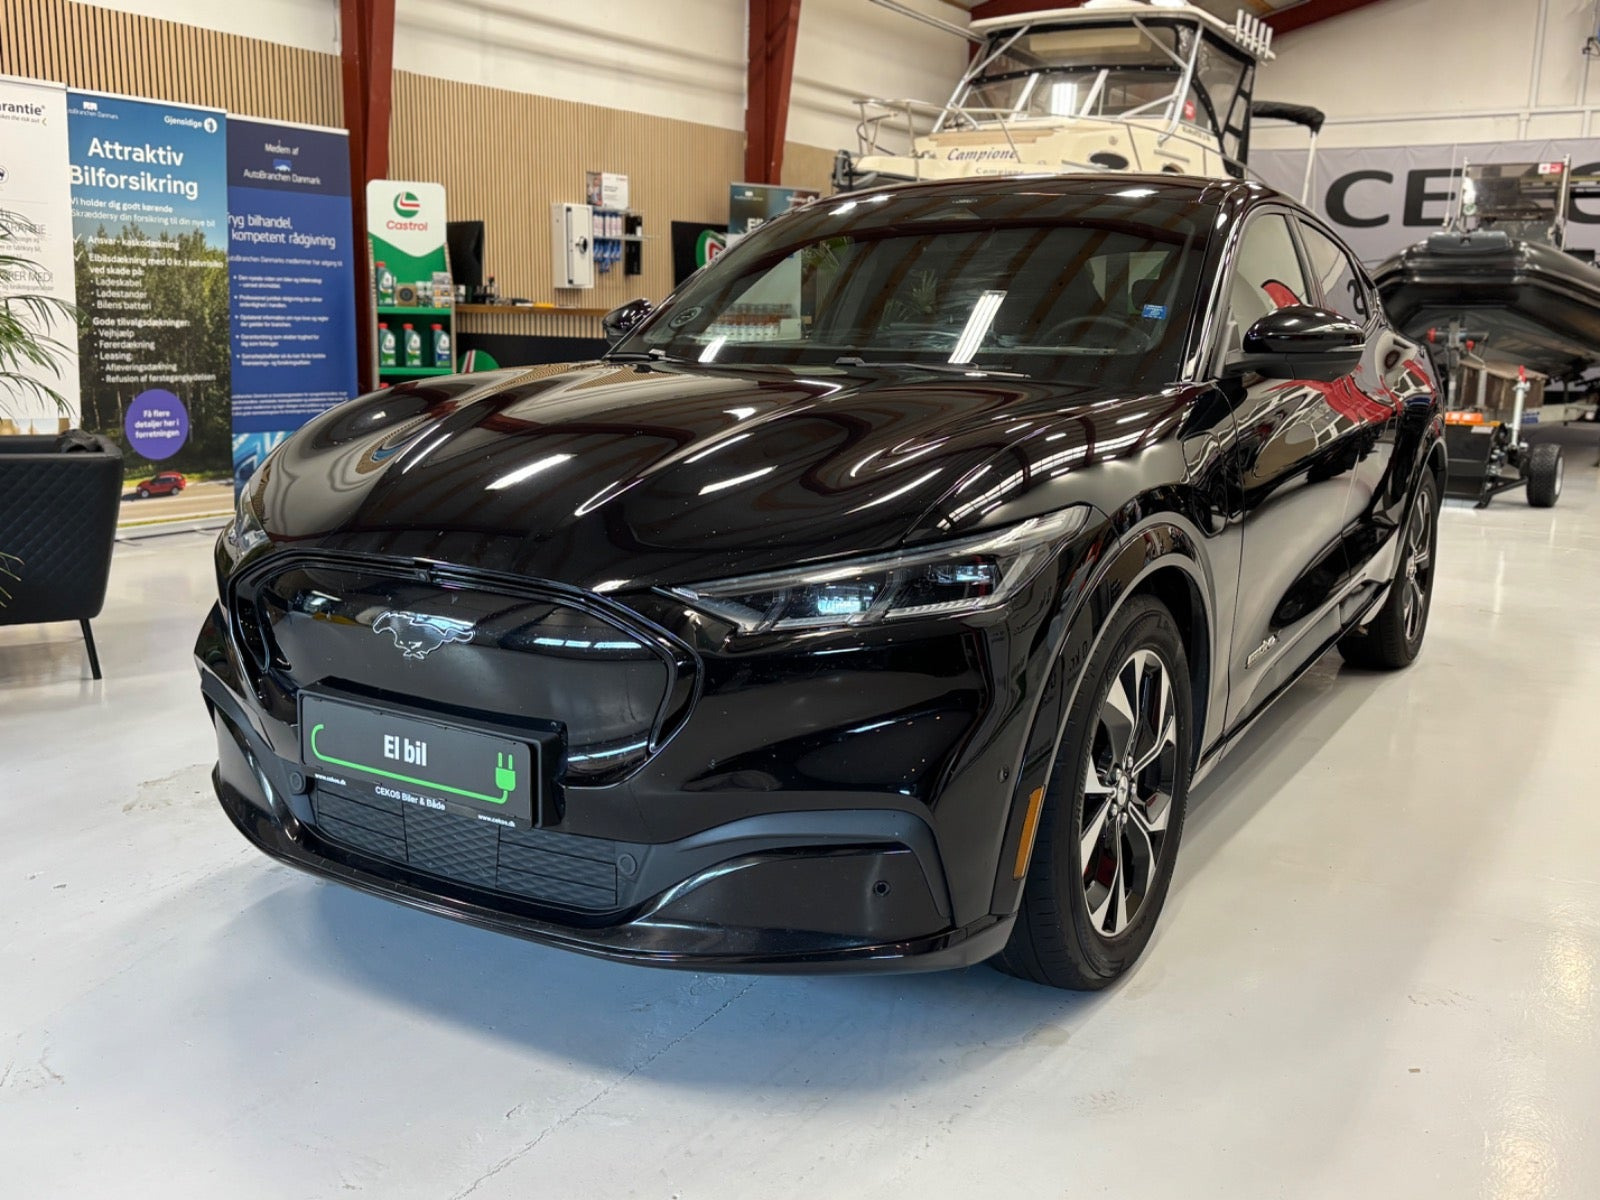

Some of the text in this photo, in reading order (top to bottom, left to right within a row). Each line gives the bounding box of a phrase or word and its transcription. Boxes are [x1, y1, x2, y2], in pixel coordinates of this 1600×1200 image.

[163, 115, 202, 129] Gjensidige
[88, 137, 184, 166] Attraktiv
[947, 147, 1018, 162] Campione
[69, 164, 198, 200] Bilforsikring
[80, 198, 106, 208] holder
[108, 199, 121, 212] dig
[122, 201, 140, 212] godt
[120, 212, 132, 221] din
[133, 213, 168, 226] forsikring
[170, 215, 178, 225] til
[179, 216, 191, 226] din
[227, 213, 245, 229] ryg
[386, 220, 428, 232] Castrol
[231, 228, 336, 250] kompetent rådgivning
[106, 267, 131, 276] skade
[95, 278, 142, 288] Ladeskabel
[96, 289, 147, 299] Ladestander
[97, 300, 122, 309] Bilens
[92, 316, 115, 326] Gode
[384, 734, 427, 767] El bil
[375, 786, 401, 800] CEKOS
[402, 791, 419, 804] Biler
[420, 797, 426, 806] &
